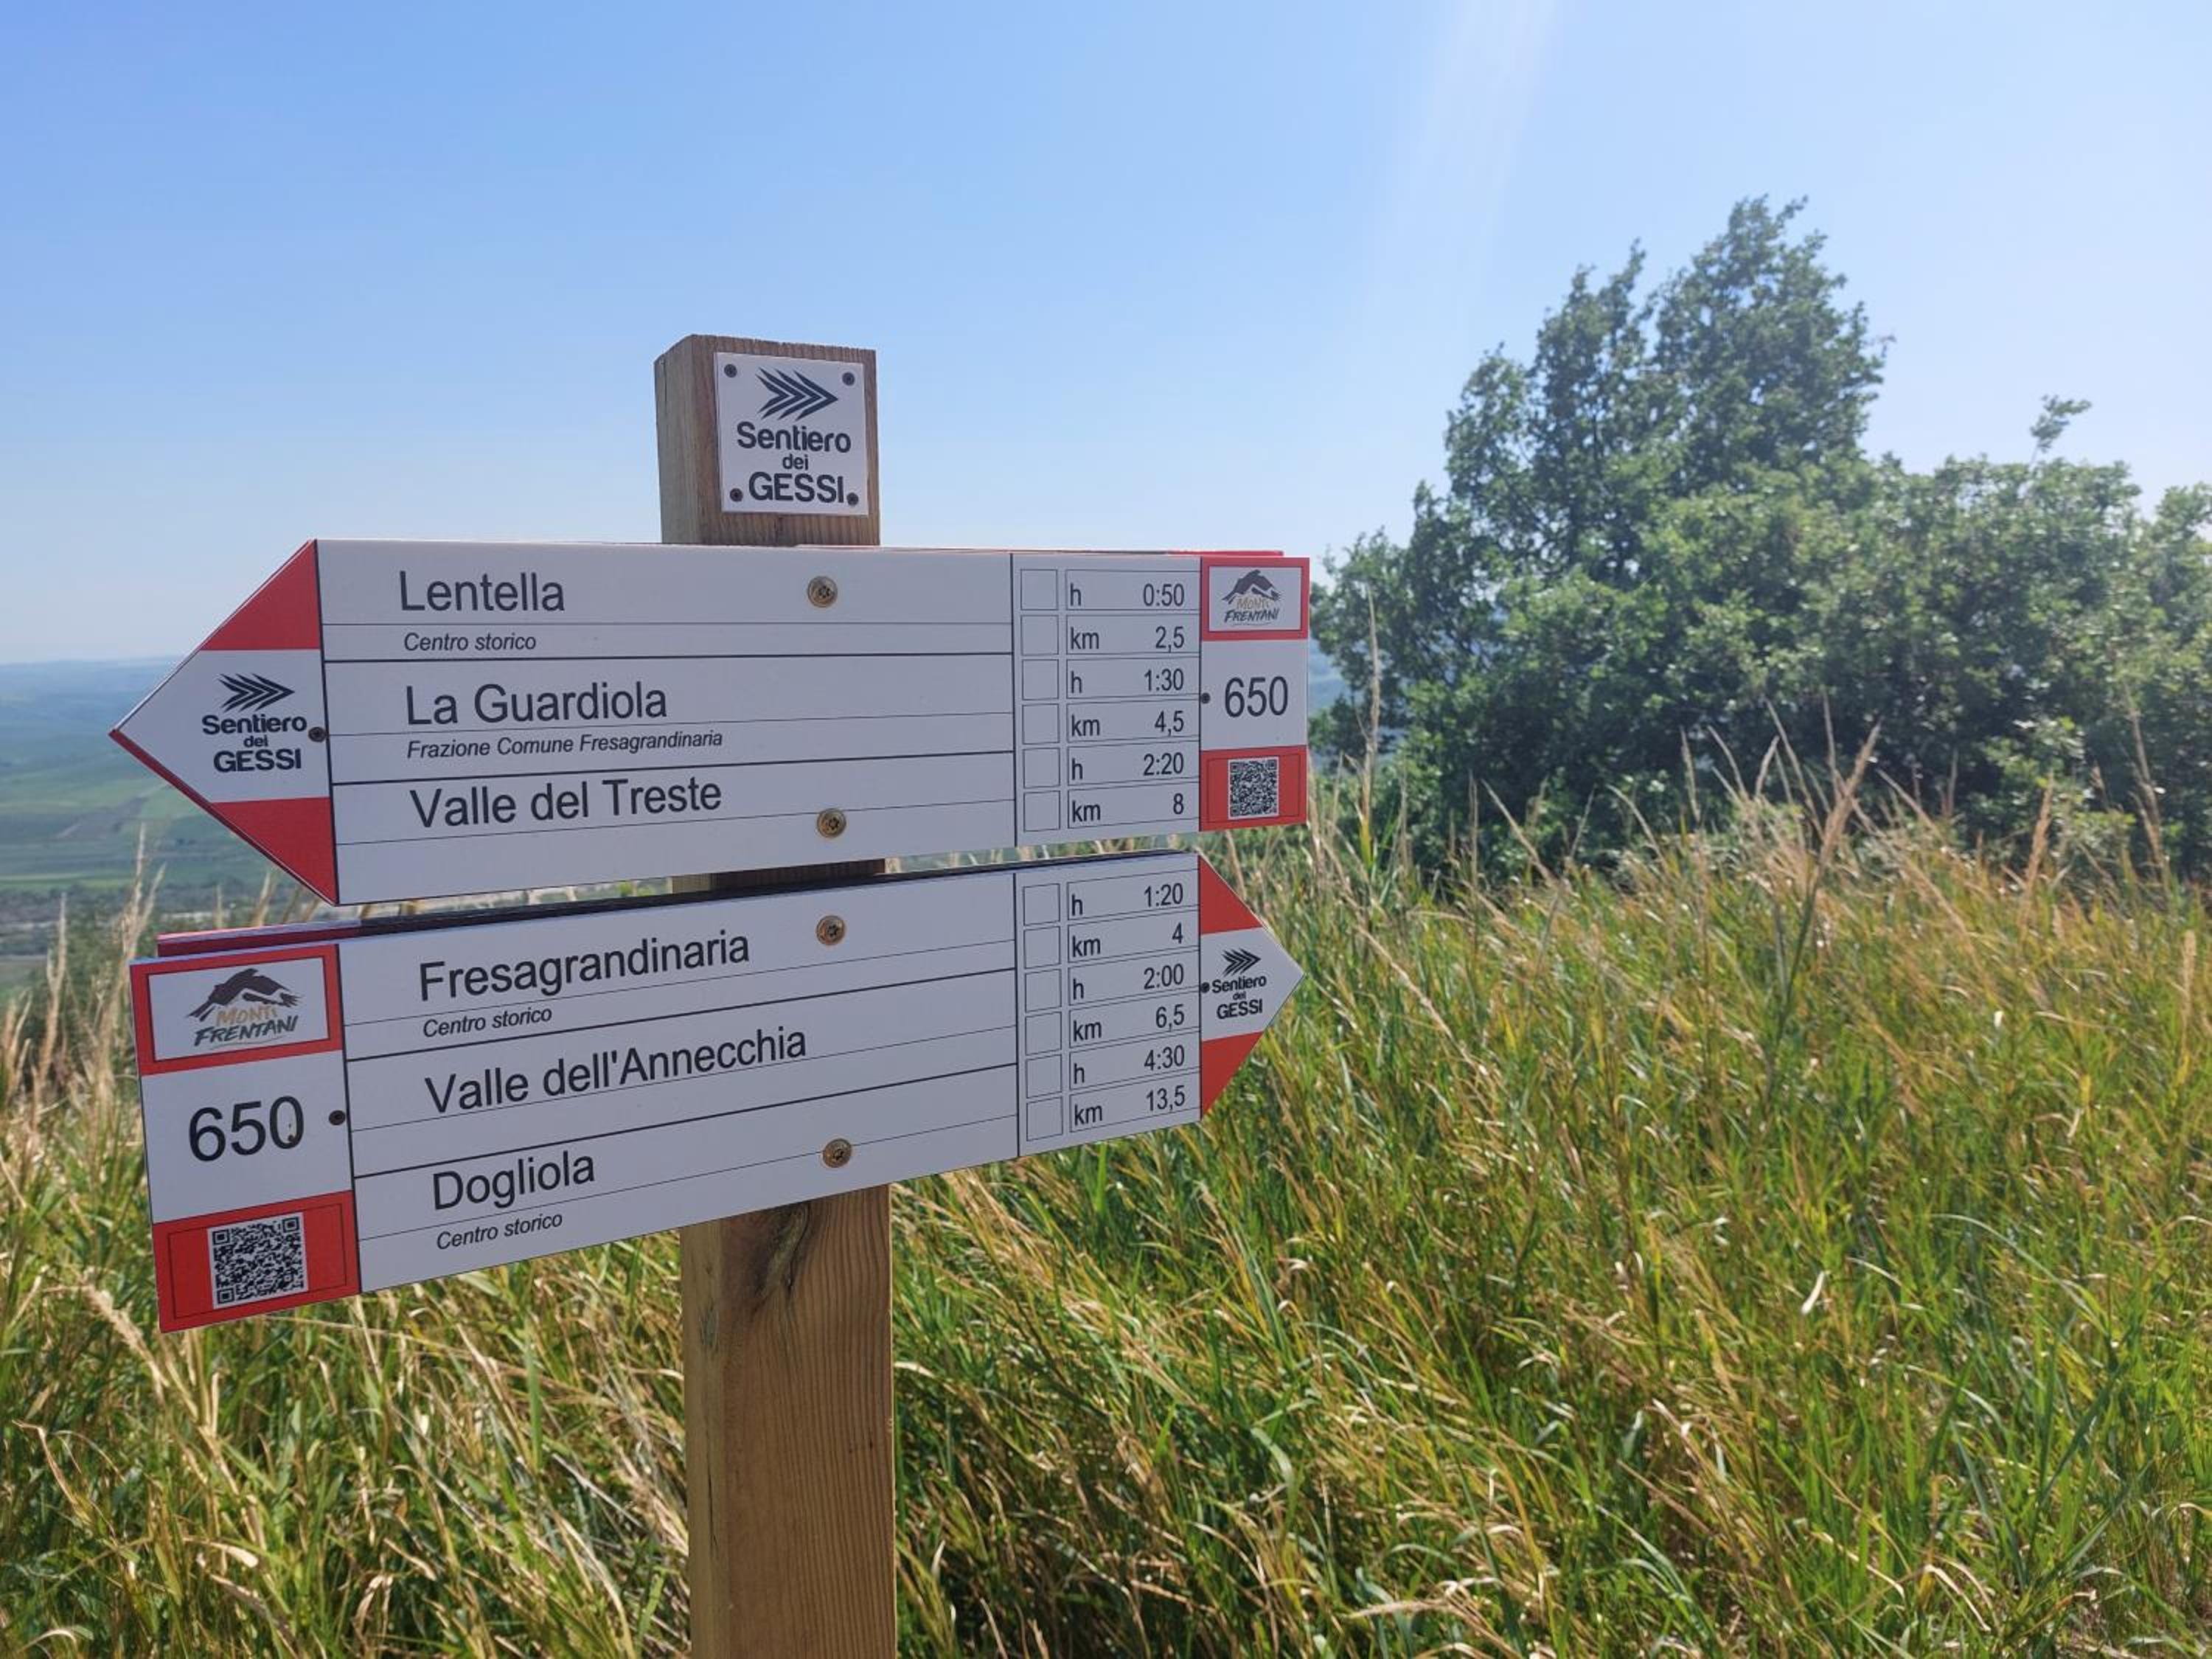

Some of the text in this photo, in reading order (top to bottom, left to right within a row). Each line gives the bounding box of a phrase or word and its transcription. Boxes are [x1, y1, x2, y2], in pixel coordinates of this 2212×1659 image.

[737, 422, 851, 453] Sentiero
[783, 454, 808, 470] dei
[748, 472, 844, 503] GESSI
[400, 571, 565, 611] Lentella
[1070, 584, 1184, 606] h 0:50
[1224, 609, 1279, 623] FRENTANI
[403, 633, 537, 652] Centro storico
[1071, 627, 1184, 653] km 2,5
[1071, 669, 1183, 693] h 1:30
[1225, 676, 1288, 717] 650
[407, 681, 667, 725] La Guardiola
[201, 714, 307, 736] Sentiero
[1071, 711, 1184, 737] km 4,5
[243, 735, 268, 748] dei
[407, 731, 723, 759] Frazione Comune Fresagrandinaria
[214, 751, 302, 773] GESSI
[1072, 753, 1183, 780] h 2:20
[410, 777, 721, 828] Valle del Treste
[1073, 793, 1183, 822] km 8
[1072, 883, 1183, 917] h 1:20
[1073, 922, 1183, 957] km 4
[420, 931, 750, 1001] Fresagrandinaria
[1074, 964, 1183, 1000] h 2:00
[1211, 975, 1267, 993] Sentiero
[1233, 990, 1246, 1001] dei
[422, 1006, 552, 1038] Centro storico
[1074, 1004, 1185, 1041] km 6,5
[1217, 1000, 1262, 1019] GESSI
[194, 1015, 299, 1046] FRENTANI
[425, 1026, 807, 1113] Valle dell'Annecchia
[1074, 1045, 1185, 1084] h 4:30
[1075, 1085, 1185, 1125] km 13,5
[188, 1096, 304, 1161] 650
[433, 1152, 595, 1210] Dogliola
[437, 1212, 563, 1250] Centro storico
